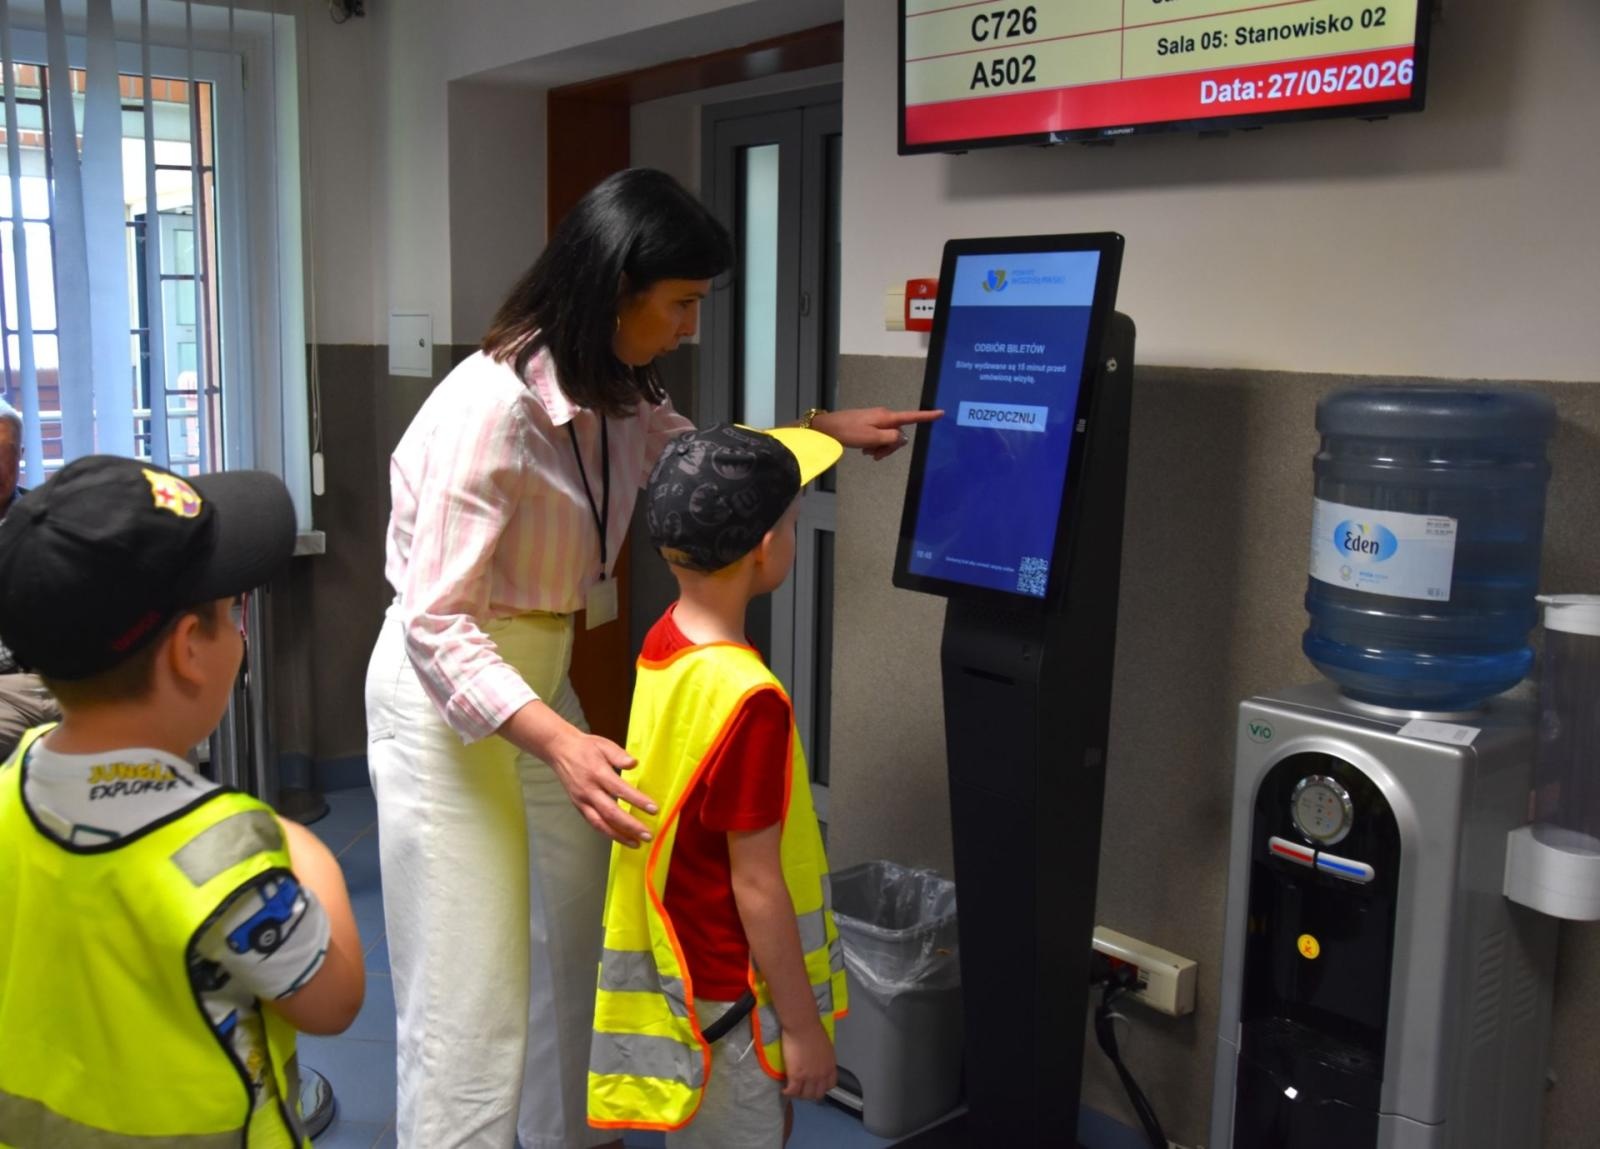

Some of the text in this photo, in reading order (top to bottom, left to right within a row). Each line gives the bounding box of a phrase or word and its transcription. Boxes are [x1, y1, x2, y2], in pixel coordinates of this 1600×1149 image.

[971, 5, 1037, 42] C726
[1157, 6, 1386, 56] Sala 05: Stanowisko 02
[970, 54, 1036, 90] A502
[975, 342, 1046, 354] ODBIÓR BILETÓW
[968, 408, 1036, 425] ROZPOCZNIJ
[1344, 531, 1379, 555] Eden
[89, 780, 178, 801] EXPLORER
